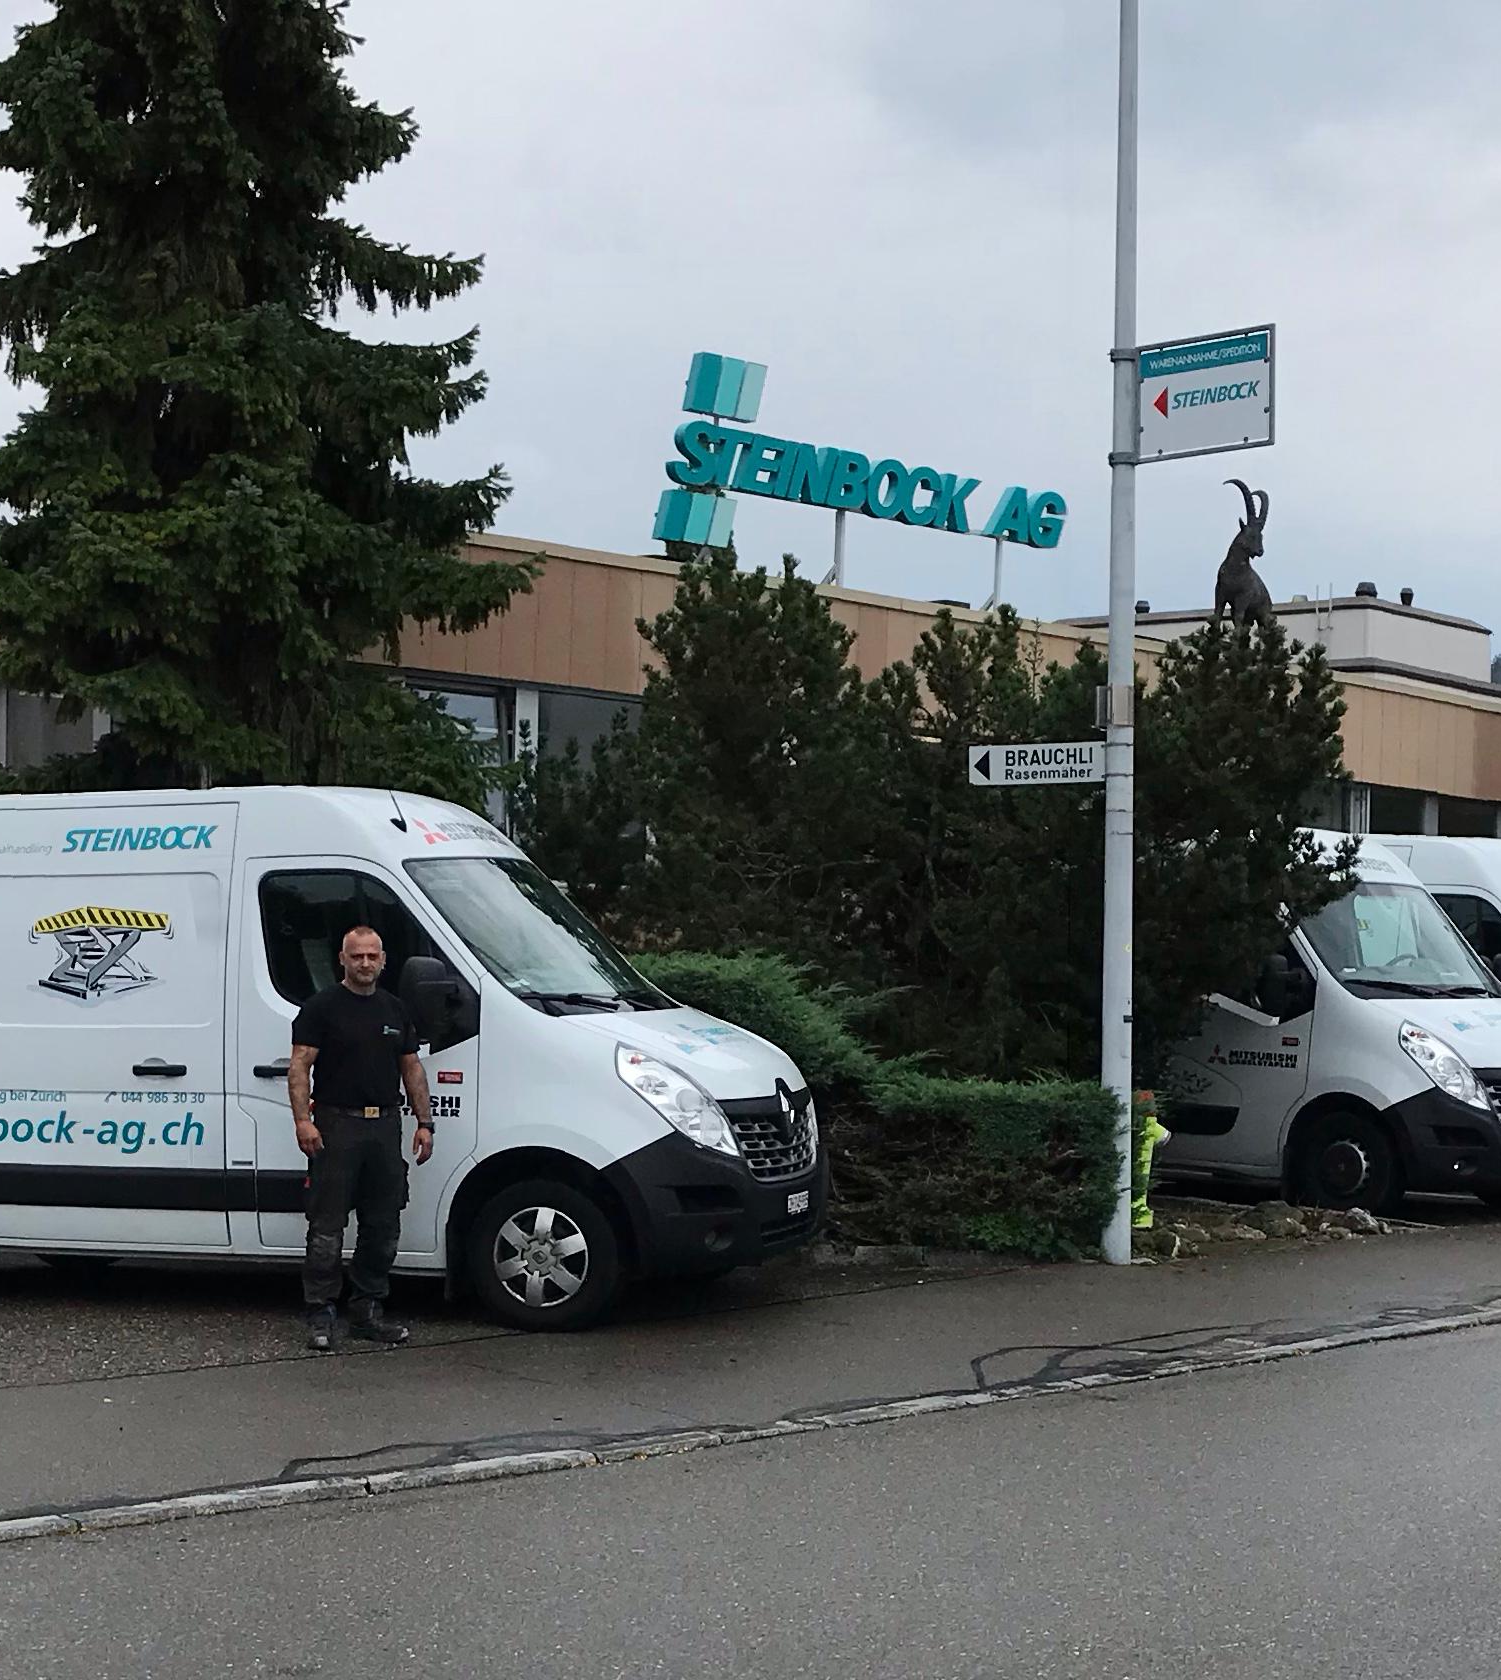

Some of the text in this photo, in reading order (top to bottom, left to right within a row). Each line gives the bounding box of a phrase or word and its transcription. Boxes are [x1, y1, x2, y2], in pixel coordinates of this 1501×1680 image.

[1149, 343, 1261, 370] WARENANNAHME/SPEDITION
[1171, 380, 1261, 410] STEINBOCK
[666, 420, 1068, 548] STEINBOCK AG
[1005, 747, 1093, 767] BRAUCHLI
[1004, 766, 1093, 780] Rasenmäher
[61, 825, 219, 853] STEINBOCK
[1229, 1050, 1298, 1063] MITSUBISHI
[9, 1089, 28, 1101] bei
[121, 1091, 206, 1104] 044 986 30 30
